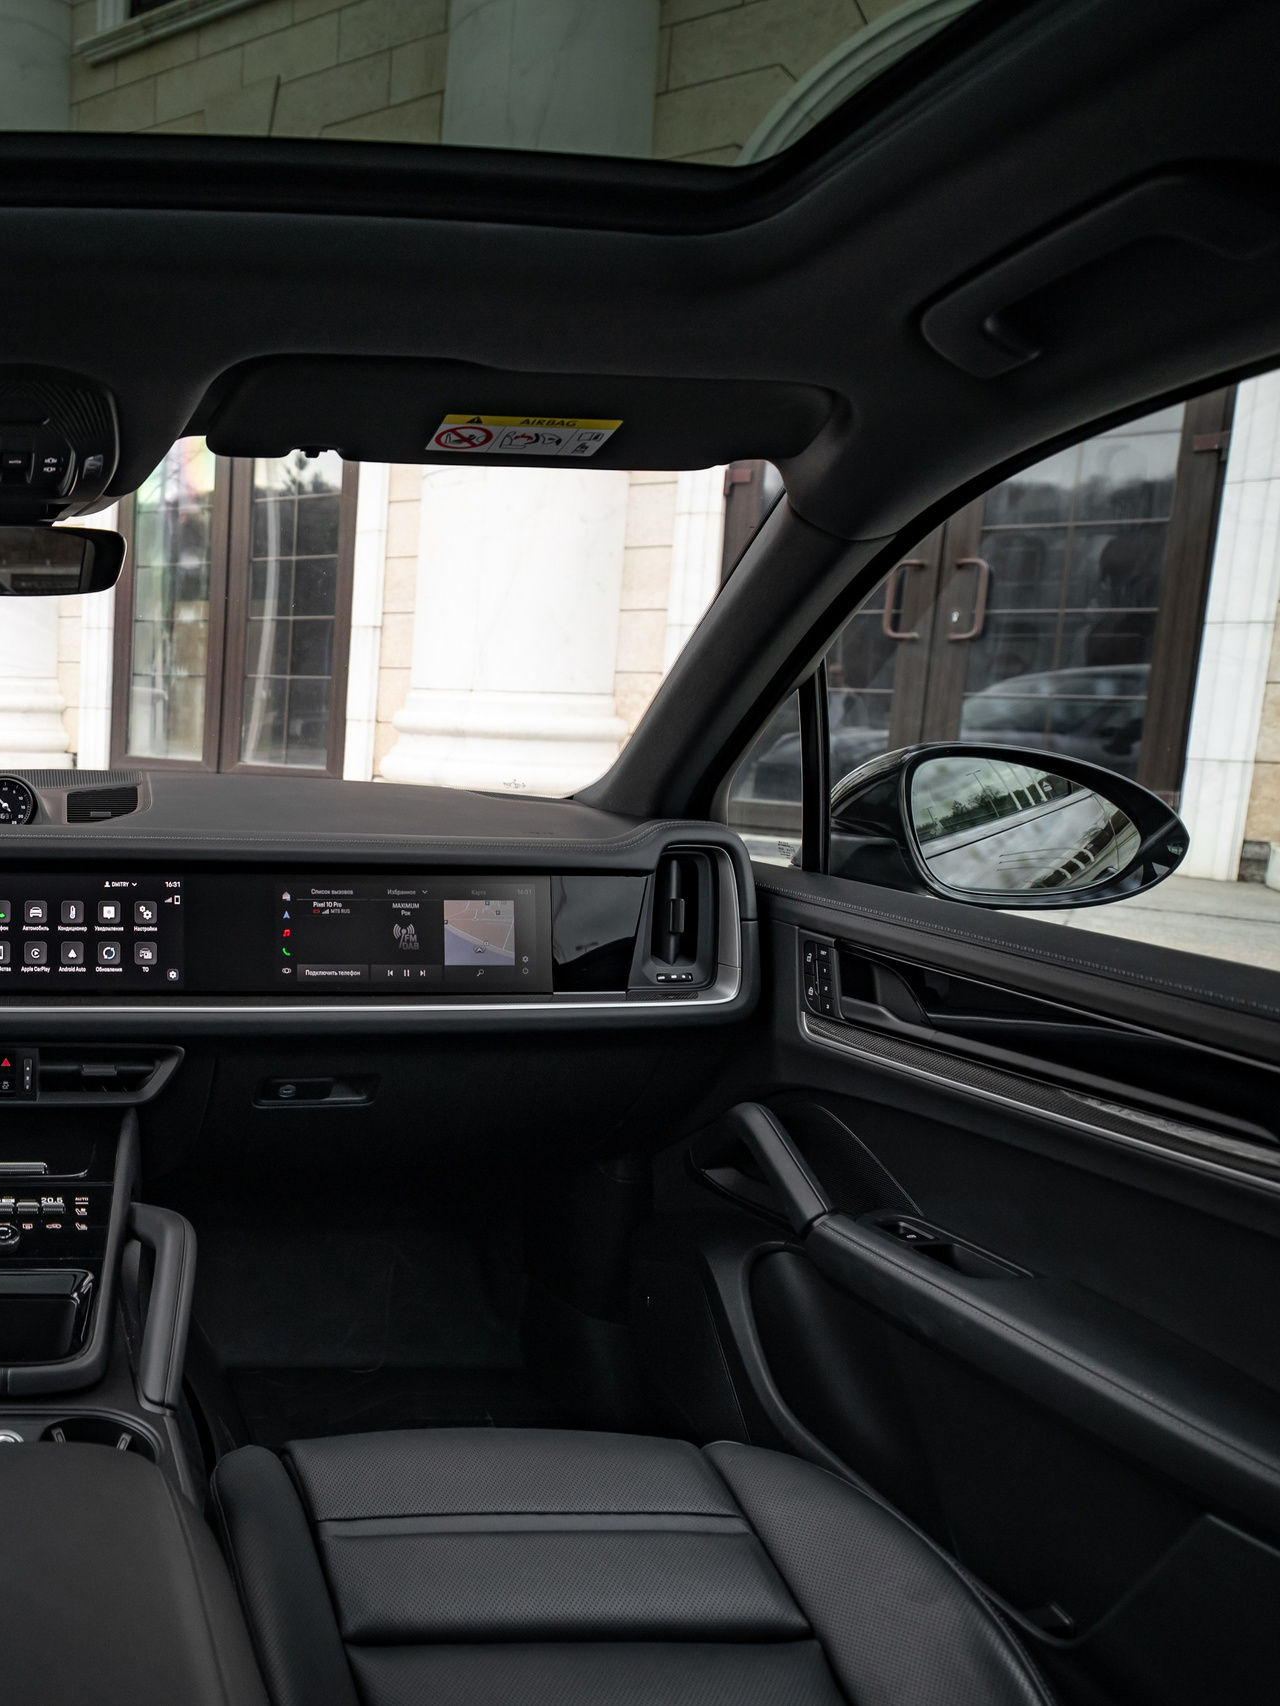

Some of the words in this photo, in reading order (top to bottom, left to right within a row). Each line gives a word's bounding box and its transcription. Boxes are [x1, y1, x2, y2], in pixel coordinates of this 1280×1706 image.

[519, 418, 578, 427] AIRBAG
[404, 934, 417, 942] FM
[402, 942, 419, 950] DAB
[305, 969, 338, 977] Подключить
